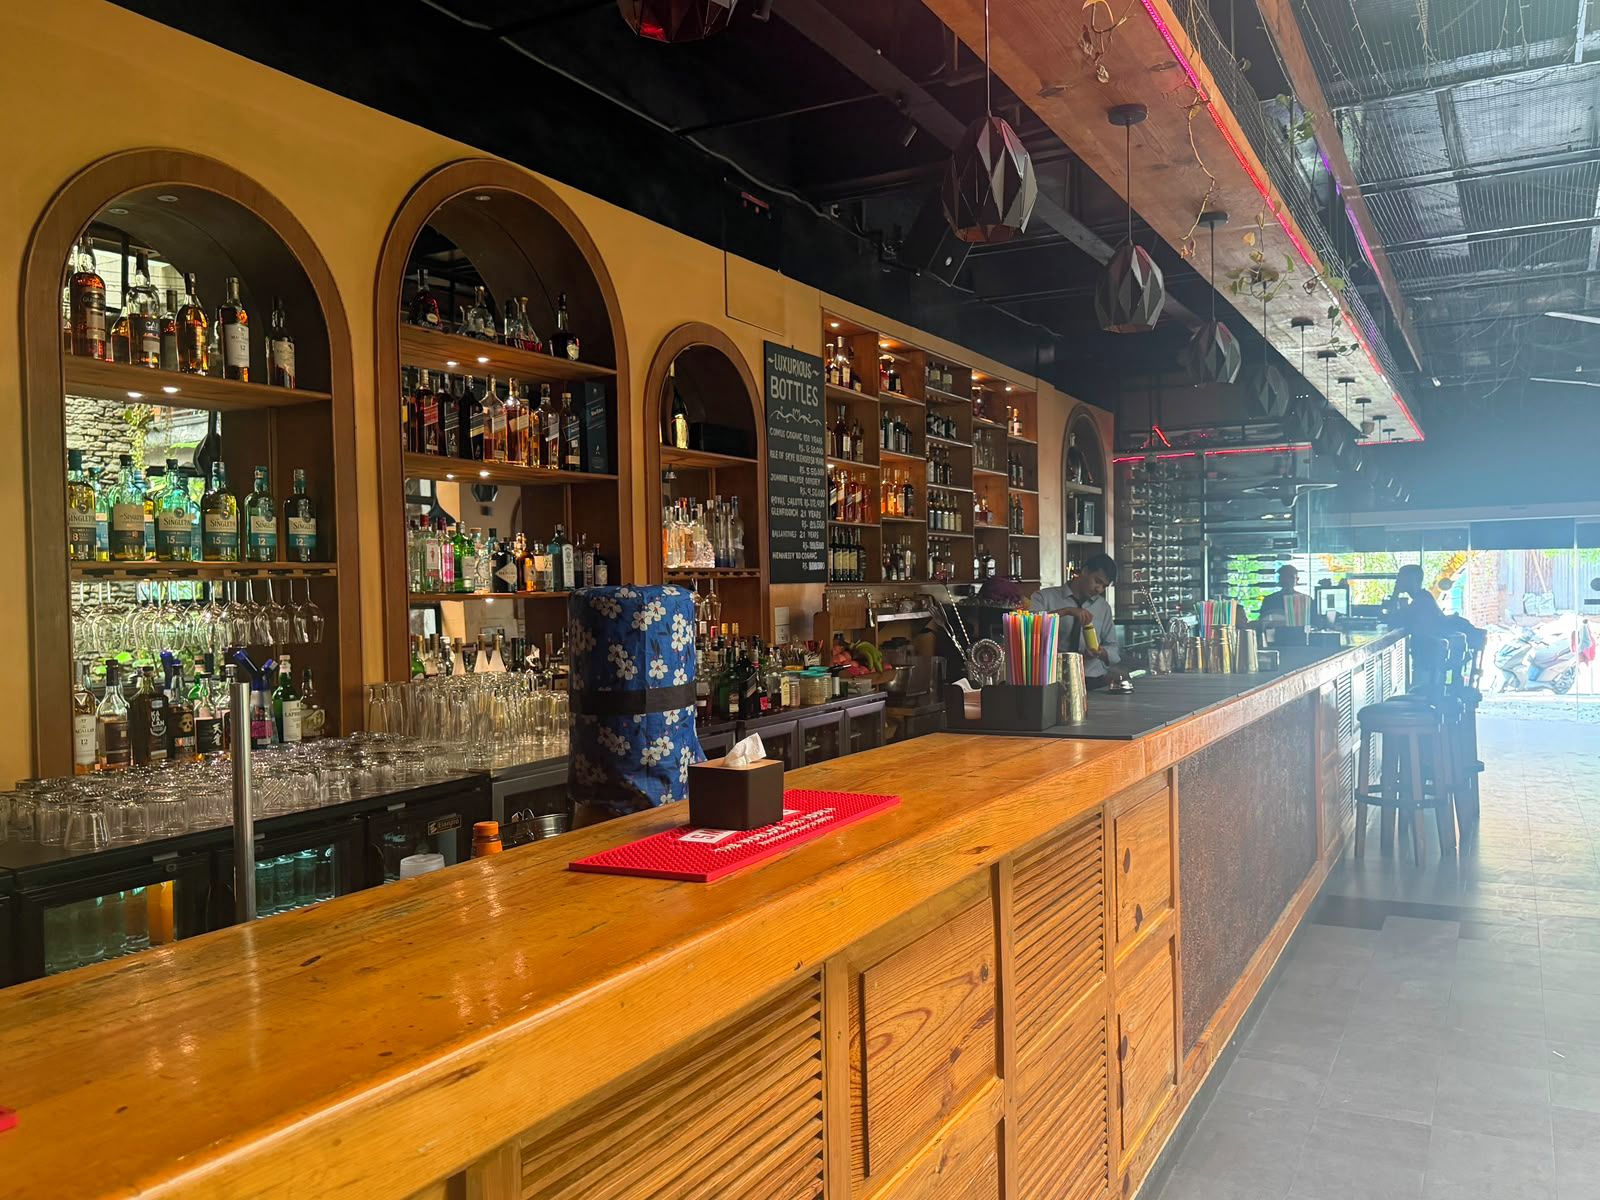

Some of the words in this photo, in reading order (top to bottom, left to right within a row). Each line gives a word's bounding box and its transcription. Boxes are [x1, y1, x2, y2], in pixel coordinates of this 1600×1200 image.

[774, 353, 812, 379] LUXURIOUS
[770, 375, 819, 407] BOTTLES
[166, 535, 176, 544] 15
[212, 536, 222, 545] 15
[258, 537, 266, 546] 12
